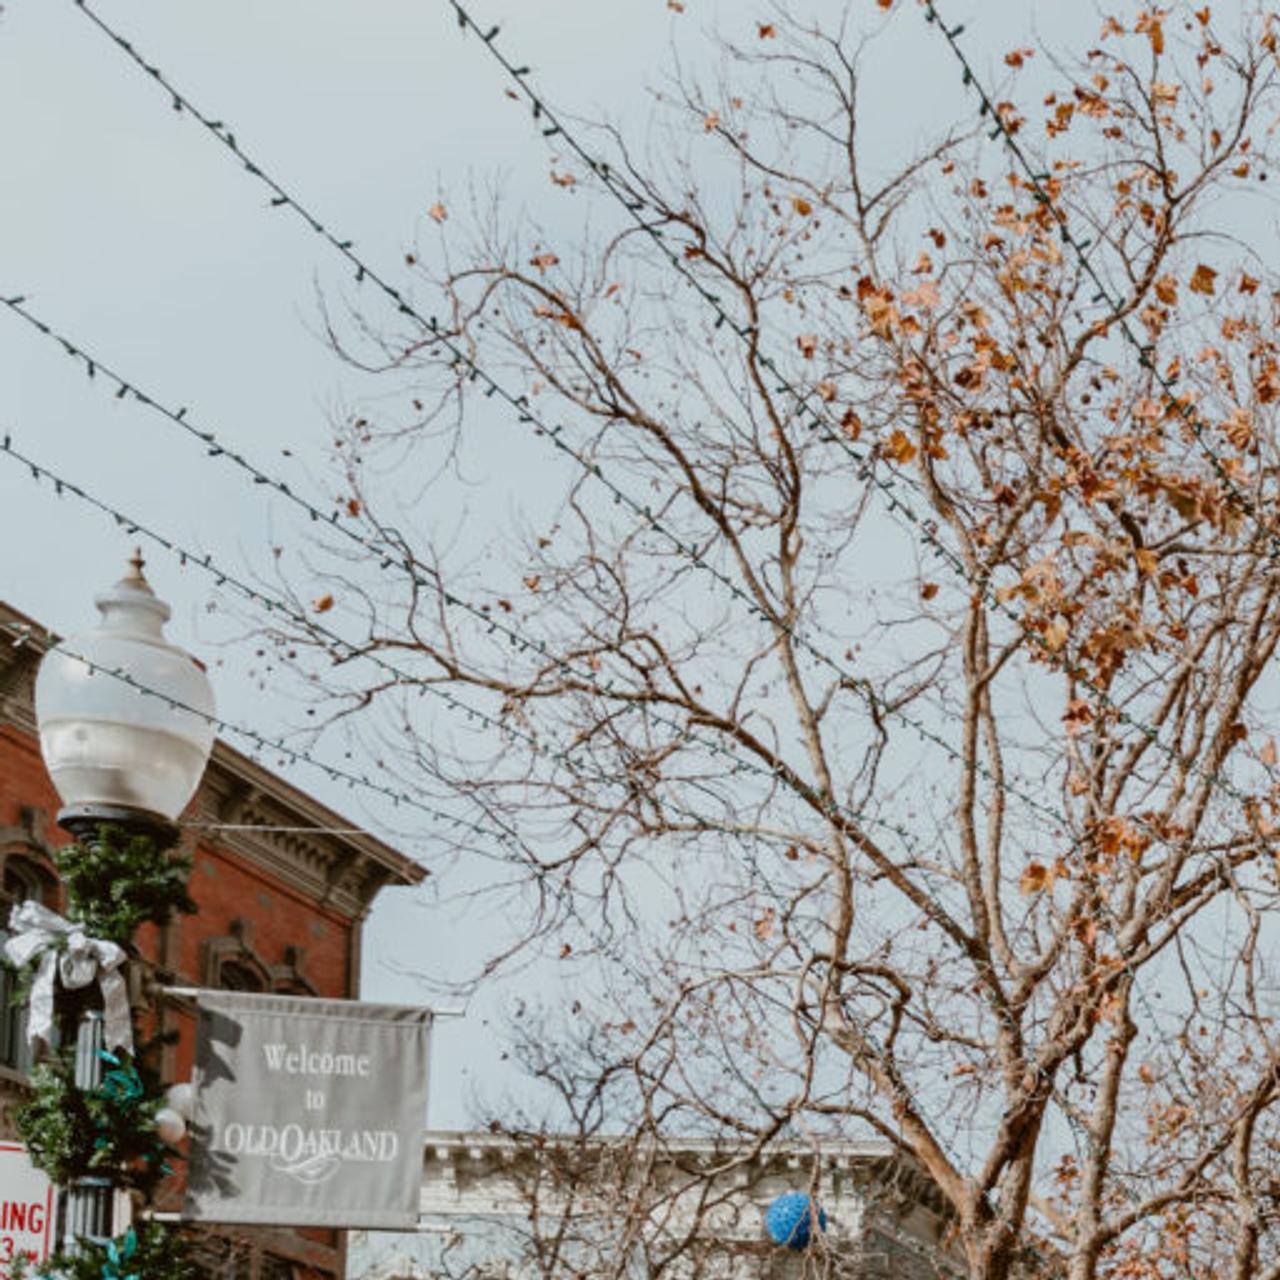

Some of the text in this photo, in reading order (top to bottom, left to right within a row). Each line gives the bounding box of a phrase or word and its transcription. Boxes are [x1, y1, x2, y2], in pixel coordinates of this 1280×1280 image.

[263, 1043, 371, 1076] Welcome
[305, 1089, 325, 1111] to
[0, 1200, 44, 1234] ING
